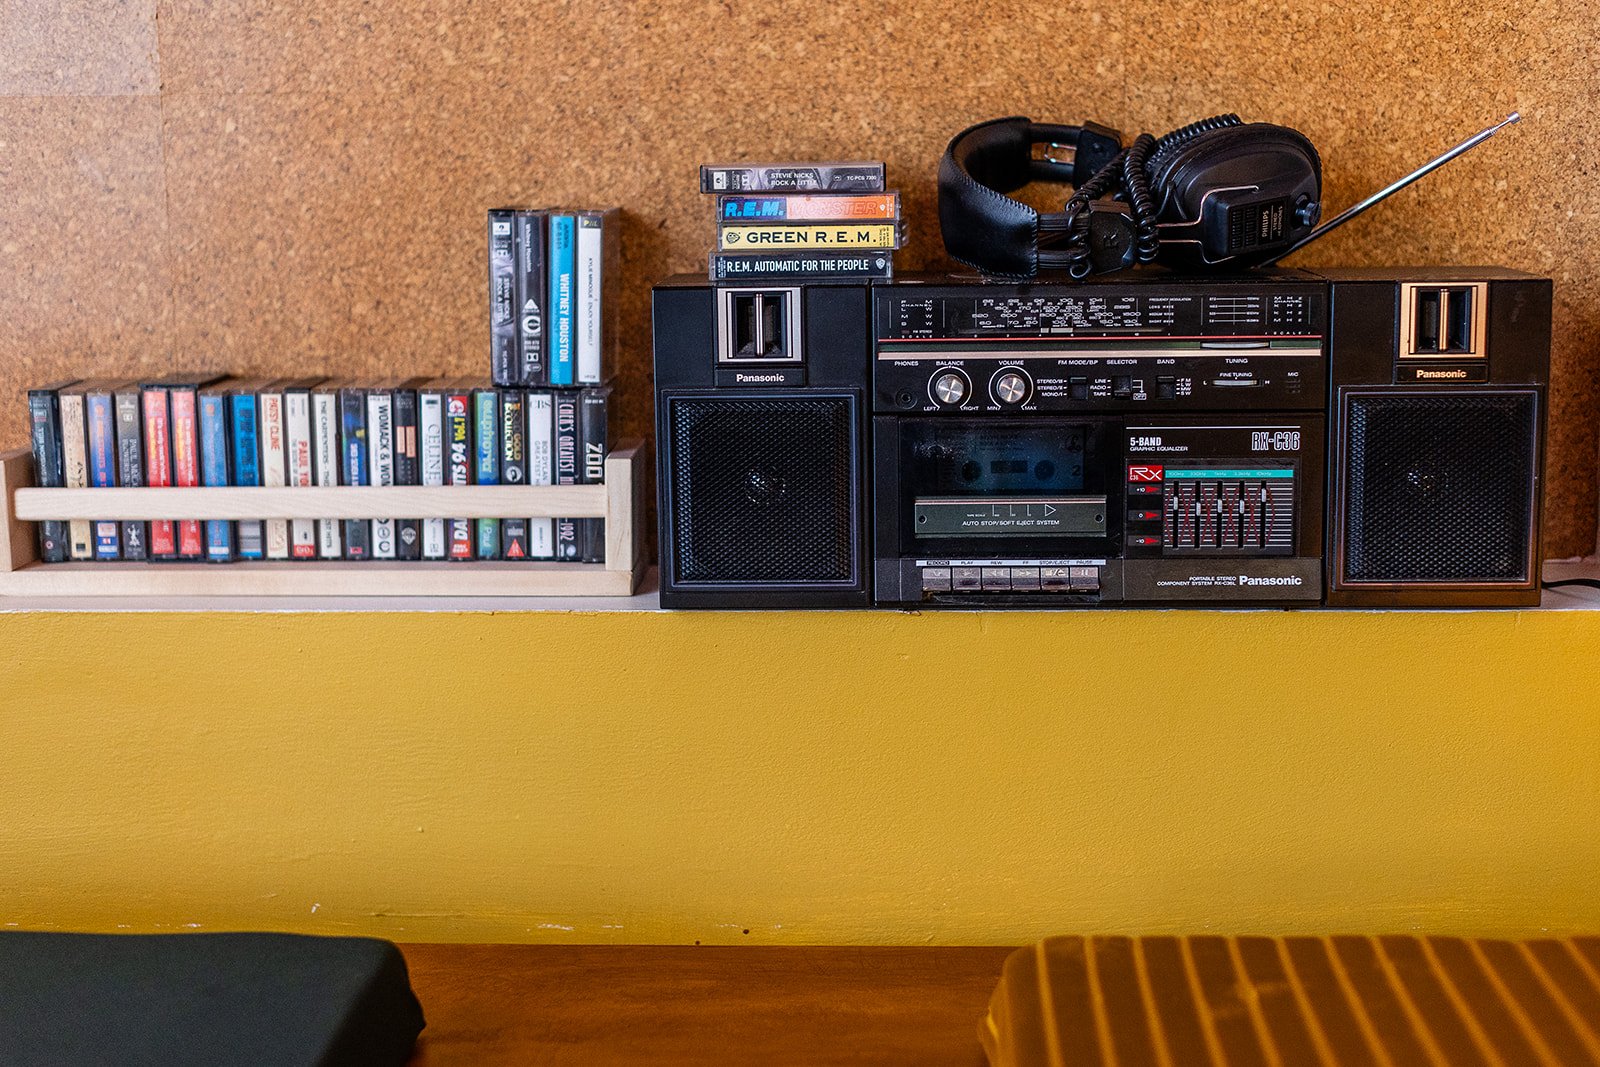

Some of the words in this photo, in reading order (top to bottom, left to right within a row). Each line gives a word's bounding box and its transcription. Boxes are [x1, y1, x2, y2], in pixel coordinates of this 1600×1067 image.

[725, 201, 784, 217] R.E.M.
[790, 201, 877, 217] MONSTER
[1262, 210, 1270, 237] PHILIPS
[746, 232, 808, 243] GREEN
[816, 232, 876, 243] R.E.M.
[727, 261, 752, 272] R.E.M.
[754, 260, 800, 272] AUTOMATIC
[801, 260, 818, 271] FOR
[820, 259, 836, 271] THE
[837, 259, 869, 270] PEOPLE
[560, 273, 570, 316] WHITNEY
[560, 318, 569, 362] HOUSTON
[736, 373, 785, 383] Panasonic
[1416, 369, 1467, 378] Panasonic
[269, 398, 278, 424] PATSY
[559, 404, 574, 432] CHER'S
[270, 426, 280, 451] CLINE
[379, 405, 389, 451] WOMACK
[481, 400, 495, 472] euphoria
[505, 410, 514, 462] COLLECTION
[428, 424, 441, 481] CELINE
[452, 442, 466, 463] 94
[559, 435, 574, 472] GREATEST
[1130, 437, 1162, 446] 5-BAND
[1252, 432, 1300, 450] RX-C36
[299, 440, 308, 468] PAUL
[586, 442, 603, 478] ZOO
[483, 526, 492, 548] Paul
[1239, 575, 1302, 586] Panasonic
